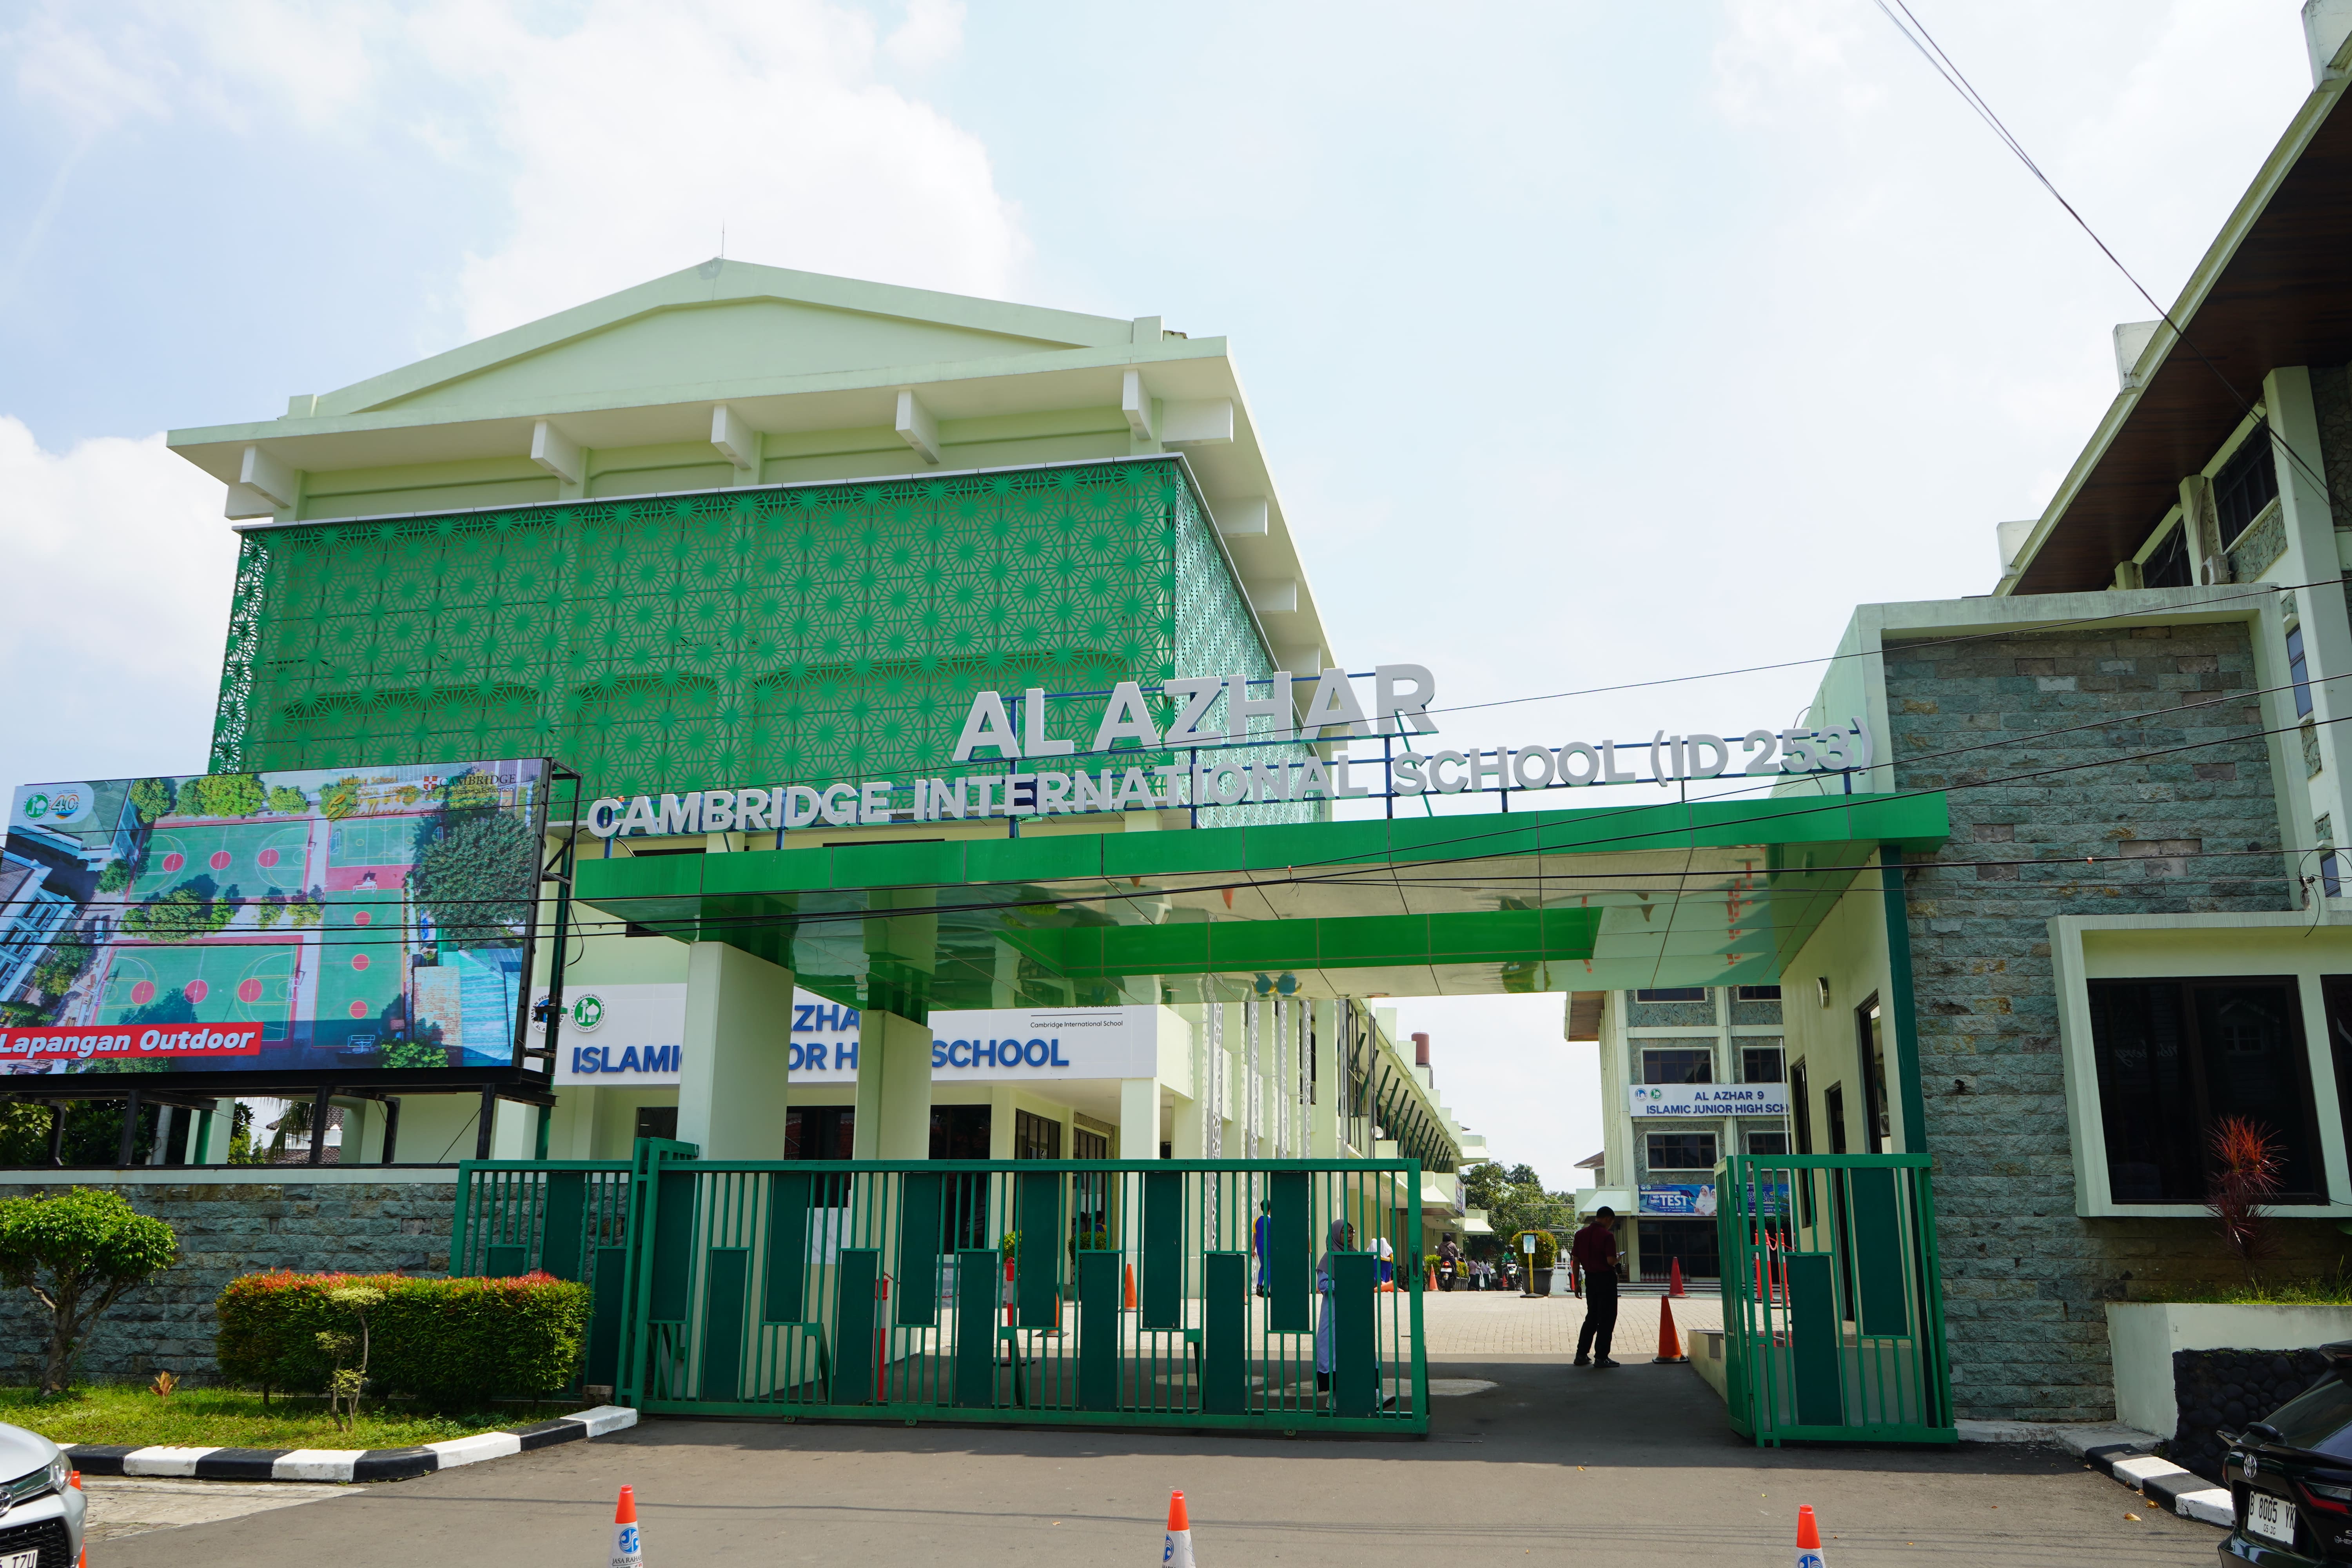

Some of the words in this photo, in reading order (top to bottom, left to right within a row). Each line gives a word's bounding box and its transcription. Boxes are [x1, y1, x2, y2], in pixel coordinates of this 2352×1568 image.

[952, 688, 1074, 761] AL
[1092, 663, 1440, 753] AZHAR
[440, 775, 516, 786] CAMBRIDGE
[588, 781, 891, 838] CAMBRIDGE
[914, 754, 1368, 820] INTERNATIONAL
[1391, 739, 1636, 797] SCHOOL
[1650, 730, 1729, 787] (ID
[1742, 716, 1873, 775] 253)
[574, 993, 591, 1004] YAYASAN
[790, 1004, 859, 1032] ZHA
[0, 1033, 131, 1058] Lapangan
[139, 1029, 256, 1052] Outdoor
[572, 1045, 682, 1073] ISLAMI
[932, 1039, 1069, 1067] SCHOOL
[1646, 1105, 1691, 1114] ISLAMIC
[1693, 1104, 1733, 1114] JUNIOR
[1735, 1104, 1763, 1113] HIGH
[1765, 1103, 1789, 1113] SCH
[1695, 1092, 1709, 1101] AL
[1713, 1091, 1753, 1100] AZHAR
[1757, 1091, 1764, 1100] 9
[1659, 1195, 1687, 1206] TEST
[2250, 1494, 2254, 1515] B
[2259, 1497, 2278, 1523] 8005
[2286, 1505, 2296, 1529] YK
